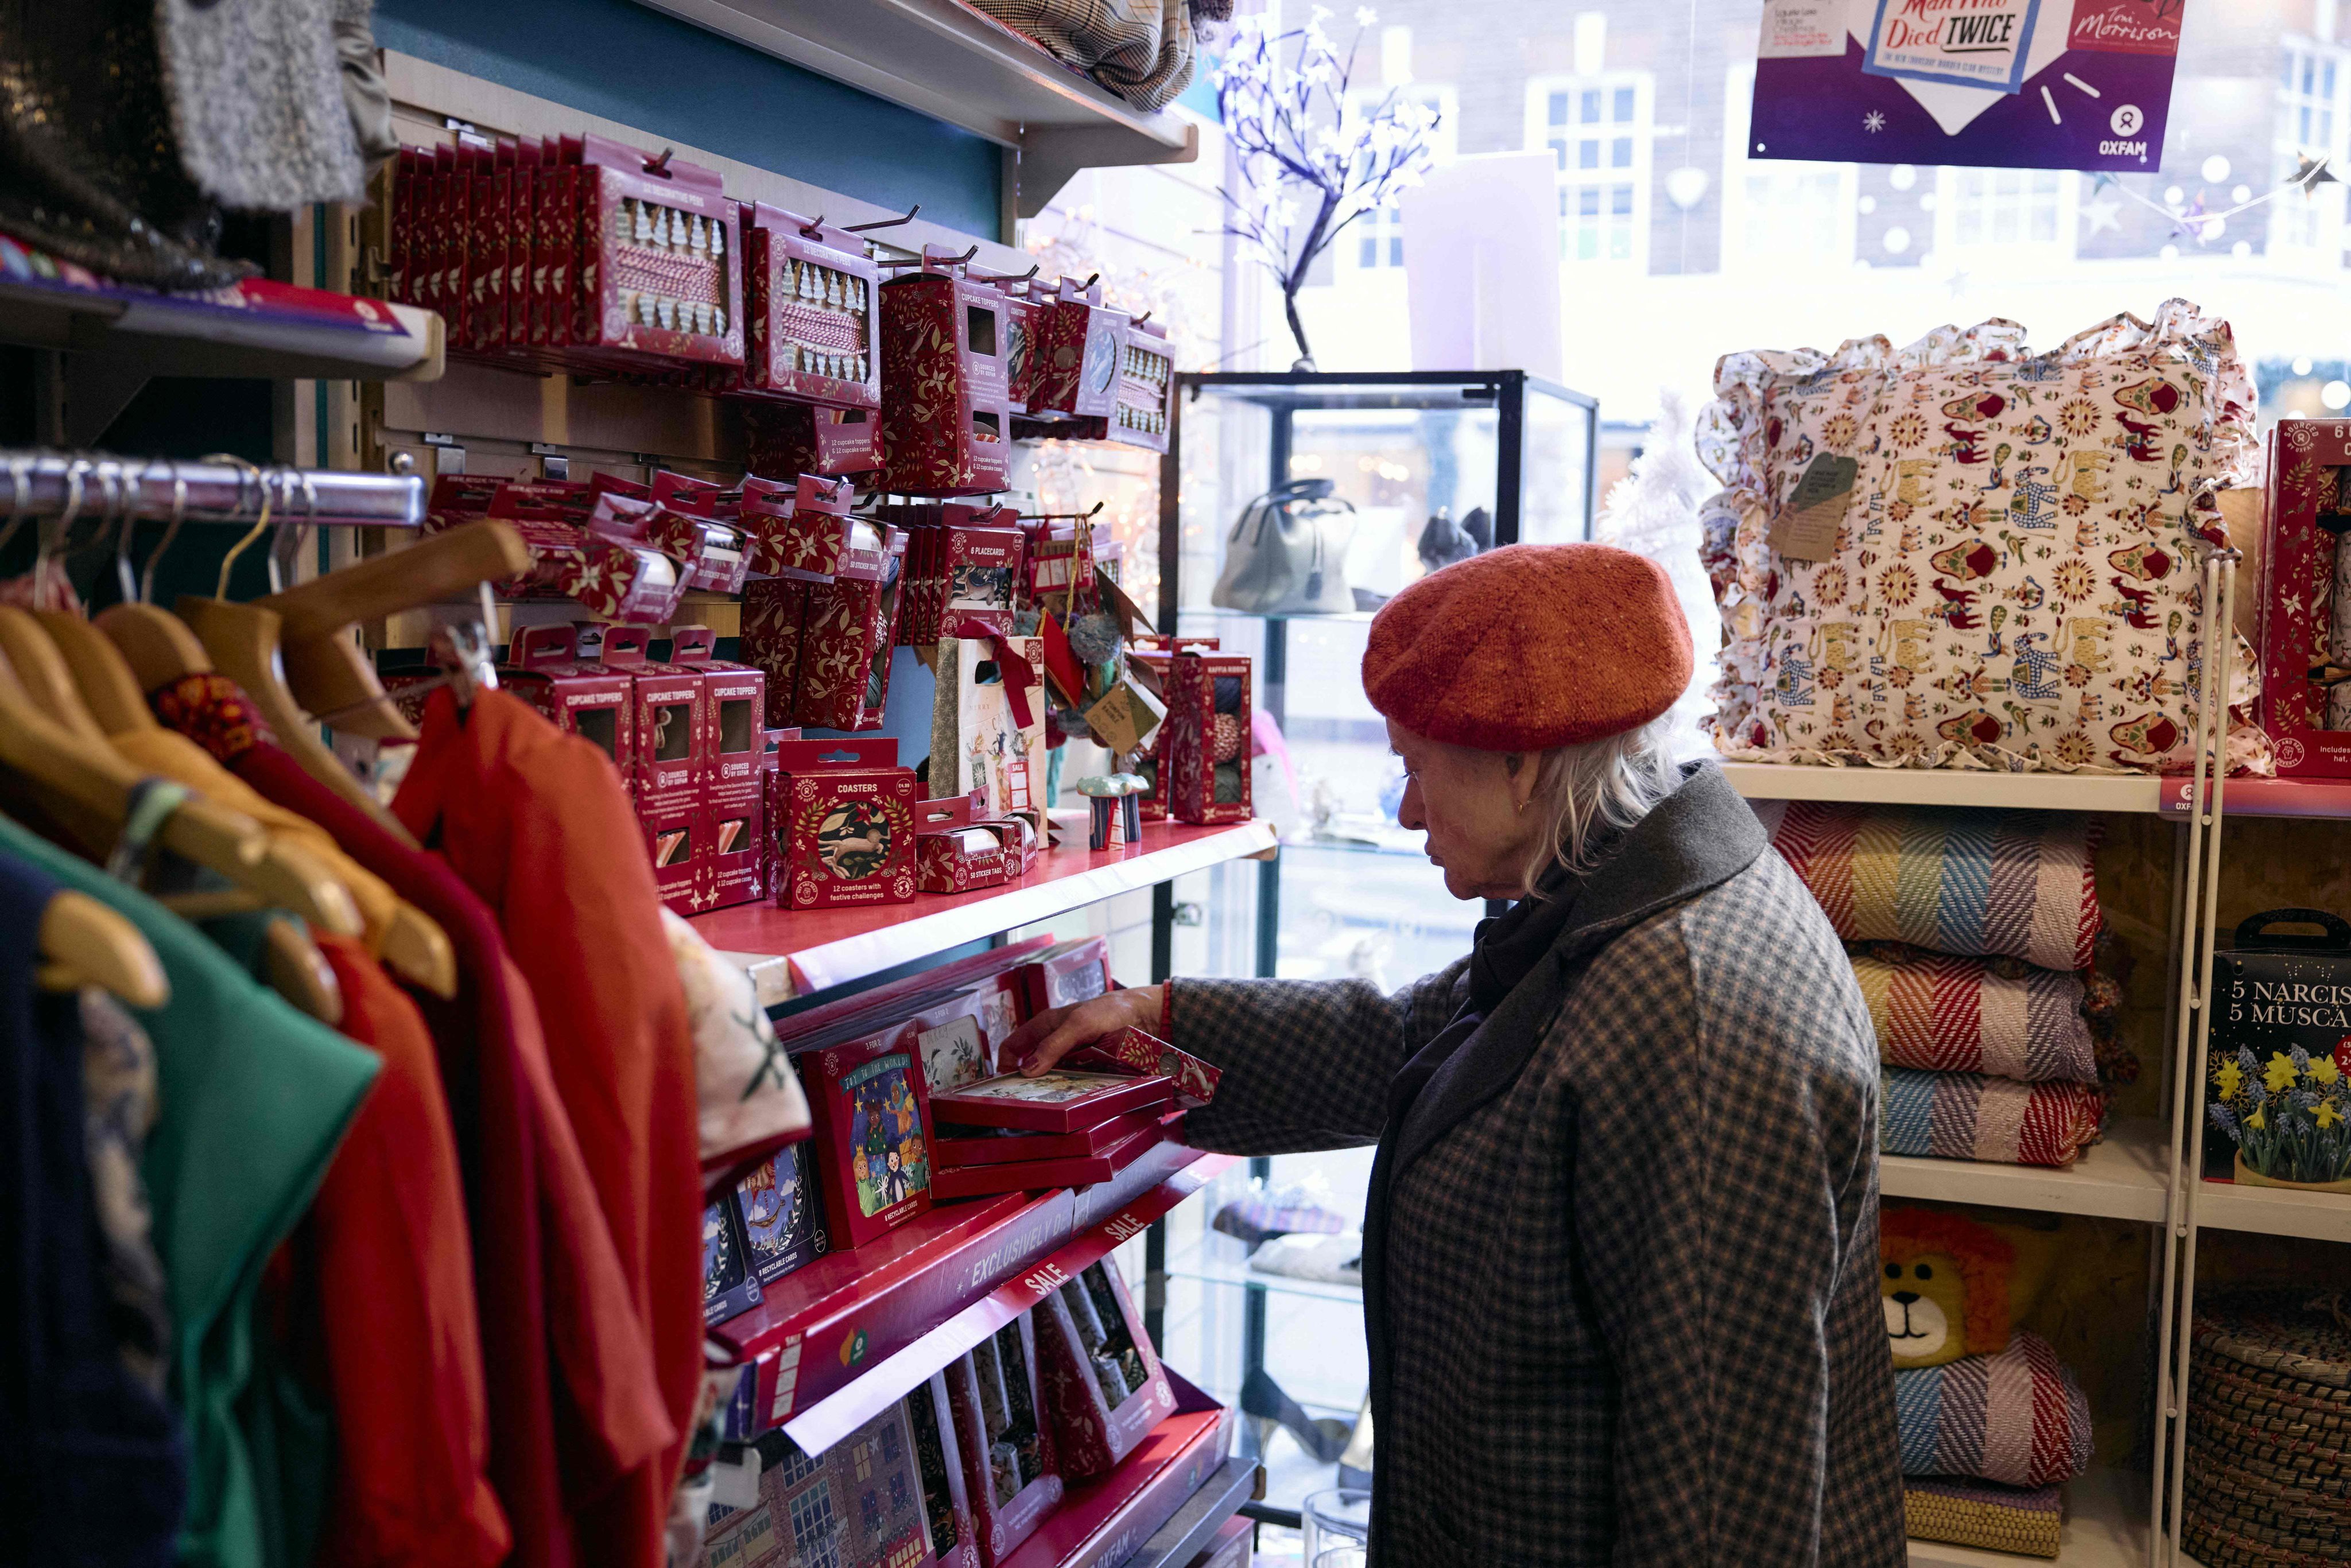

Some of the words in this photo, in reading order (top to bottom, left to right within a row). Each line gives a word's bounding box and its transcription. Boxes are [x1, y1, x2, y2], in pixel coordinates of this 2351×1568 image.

[1886, 17, 1945, 49] Died
[1946, 14, 2015, 45] TWICE
[2074, 13, 2179, 41] Morrison
[2099, 140, 2147, 156] OXFAM
[811, 247, 839, 263] DECORATIVE
[839, 255, 851, 267] PEGS
[961, 293, 981, 304] CUPCAKE
[981, 297, 999, 308] TOPPERS
[1011, 308, 1027, 317] COASTERS
[980, 364, 996, 372] SOURCED
[2284, 422, 2319, 437] SOURCED
[2334, 425, 2344, 438] 6
[2296, 443, 2315, 453] OXFAM
[951, 531, 967, 542] SOURCED
[894, 545, 905, 553] RIBBON
[975, 547, 1005, 556] PLACECARDS
[855, 561, 870, 569] STICKER
[870, 562, 878, 571] TAGS
[1026, 641, 1042, 652] SOURCED
[647, 693, 672, 703] CUPCAKE
[672, 690, 695, 700] TOPPERS
[714, 688, 736, 697] CUPCAKE
[736, 686, 756, 695] TOPPERS
[567, 694, 596, 705] CUPCAKE
[596, 692, 623, 703] TOPPERS
[2320, 746, 2351, 754] Includes
[731, 762, 749, 770] SOURCED
[1012, 764, 1023, 772] SALE
[796, 778, 818, 790] SOURCED
[837, 784, 878, 793] COASTERS
[723, 869, 738, 878] cupcake
[738, 867, 751, 876] toppers
[976, 869, 991, 878] STICKER
[726, 878, 741, 886] cupcake
[894, 876, 906, 887] PLASTIC
[852, 892, 884, 901] challenges
[893, 890, 914, 899] RECYCLABLE
[2232, 980, 2245, 999] 5
[2253, 981, 2351, 1005] NARCIS
[2229, 1003, 2243, 1021] 5
[2251, 1003, 2351, 1028] MUSCA
[825, 1053, 839, 1066] SOURCED
[845, 1074, 857, 1089] JOY
[871, 1064, 881, 1073] THE
[884, 1057, 908, 1068] WORLD!
[887, 1205, 907, 1220] RECYCLABLE
[907, 1200, 918, 1210] CARDS
[1104, 1213, 1146, 1241] SALE
[971, 1220, 1052, 1287] EXCLUSIVELY
[1053, 1213, 1065, 1237] D
[762, 1257, 785, 1275] RECYCLABLE
[785, 1252, 797, 1264] CARDS
[1025, 1263, 1070, 1295] SALE
